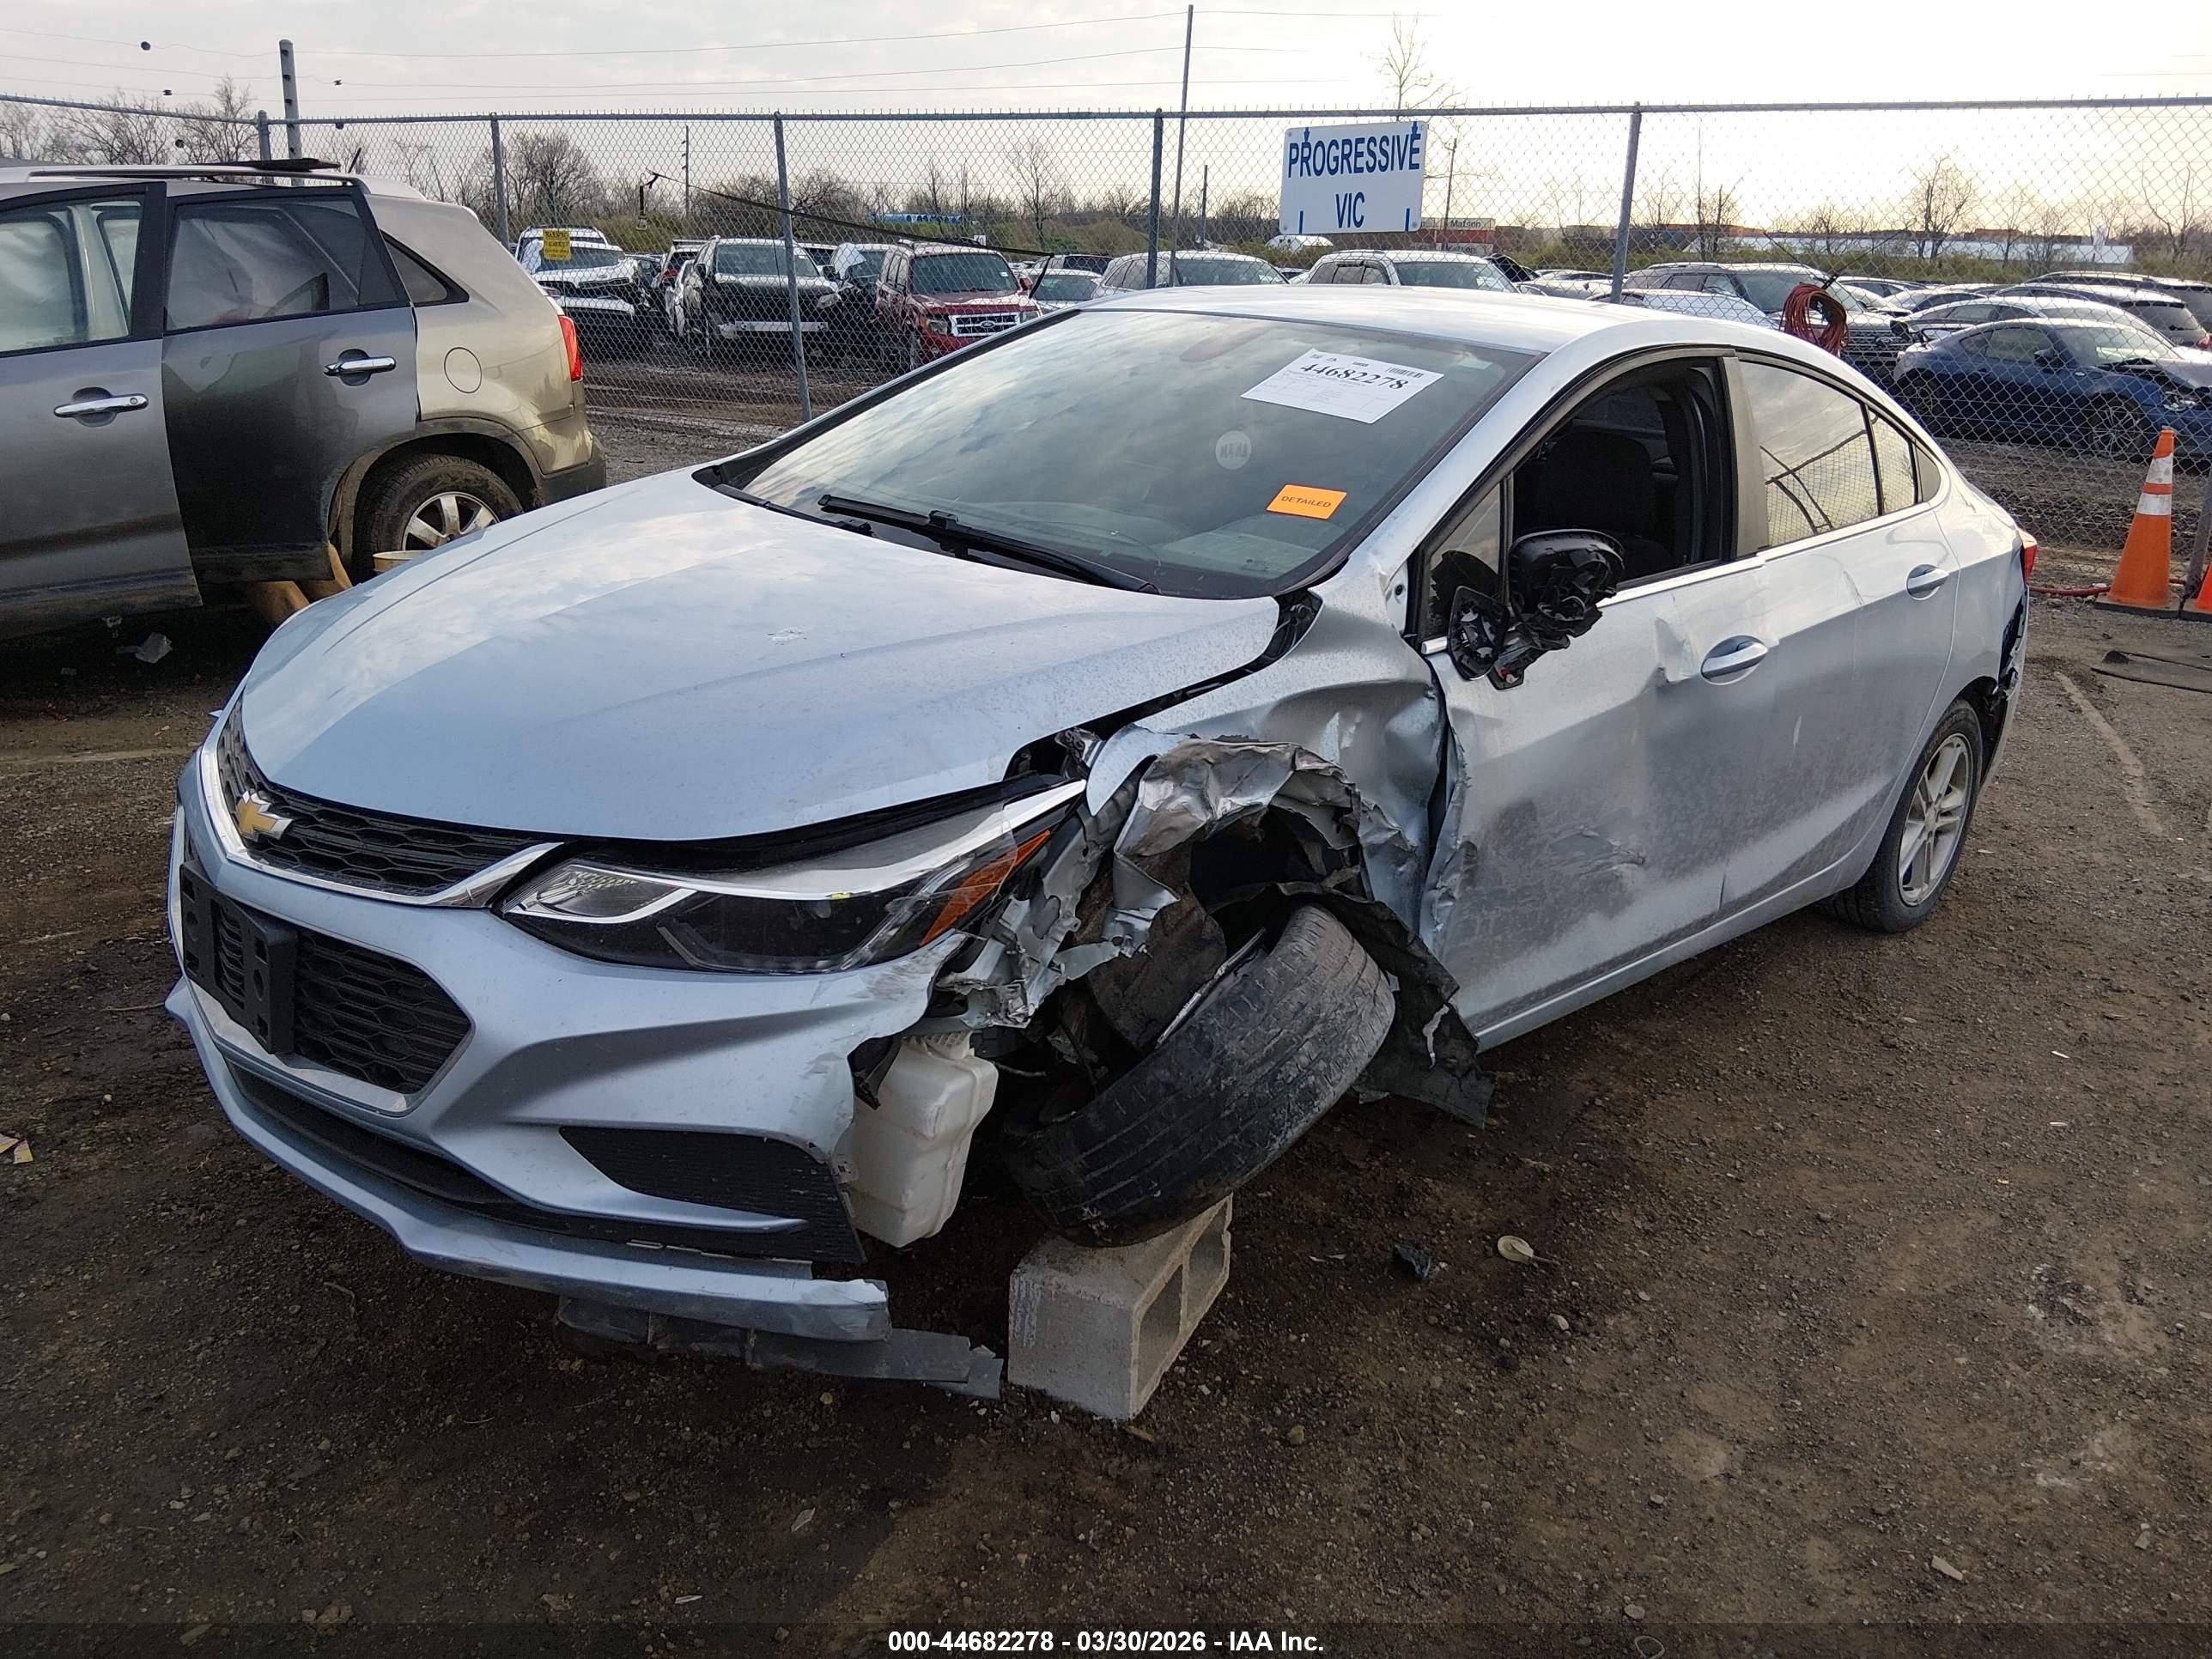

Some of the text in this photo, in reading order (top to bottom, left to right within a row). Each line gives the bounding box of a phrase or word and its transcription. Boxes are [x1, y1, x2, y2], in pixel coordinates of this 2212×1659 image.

[1288, 133, 1421, 178] PROGRESSIVE
[1335, 191, 1364, 228] VIC
[1450, 219, 1480, 228] Matson
[1300, 364, 1408, 389] 44682278
[1281, 495, 1331, 507] DETAILED
